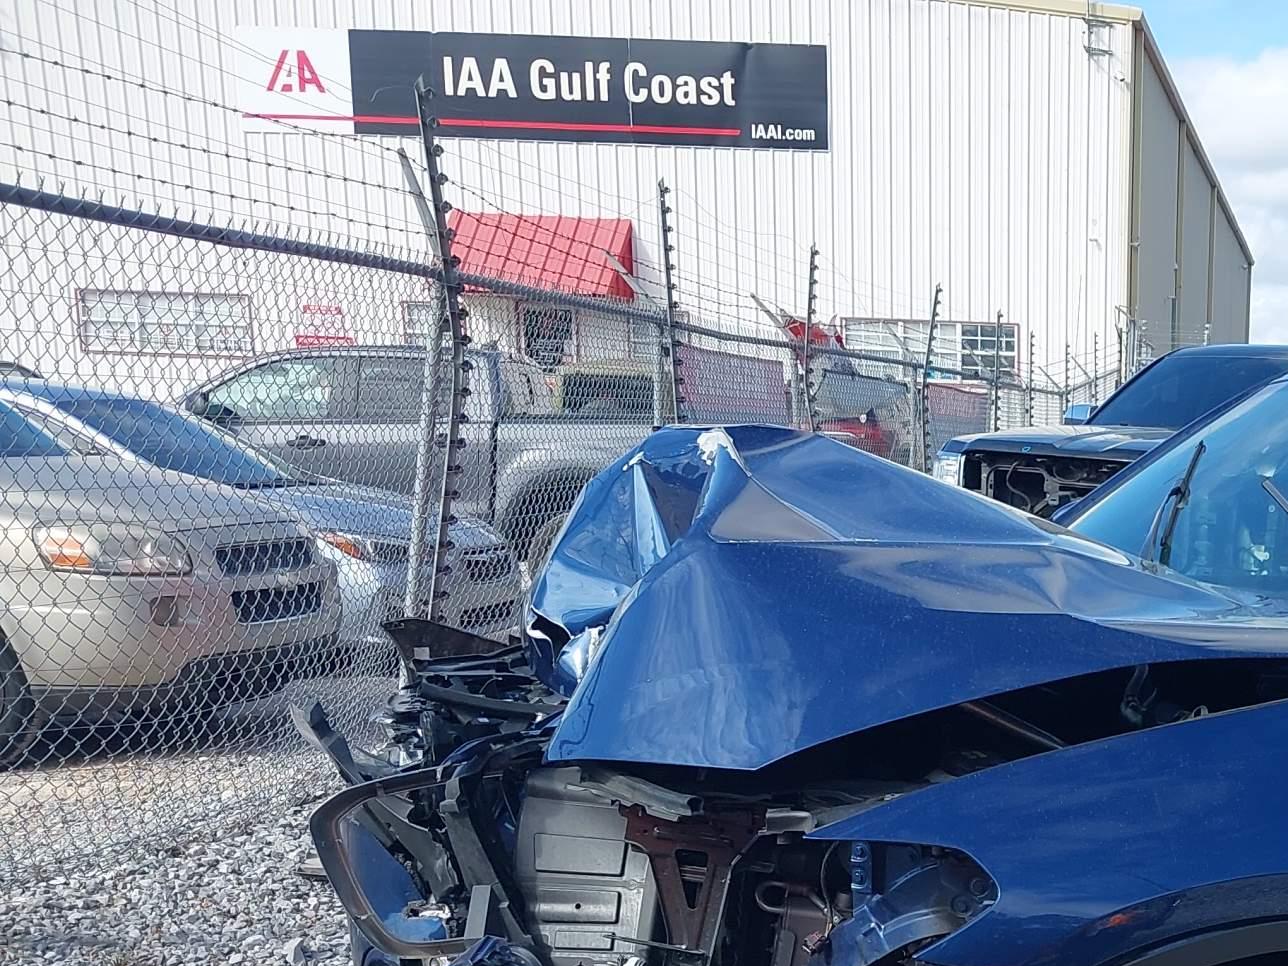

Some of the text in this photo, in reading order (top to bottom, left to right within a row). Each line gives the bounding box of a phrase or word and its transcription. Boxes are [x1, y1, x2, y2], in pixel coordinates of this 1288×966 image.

[443, 56, 736, 107] IAA Gulf Coast
[750, 123, 817, 142] IAAI.com
